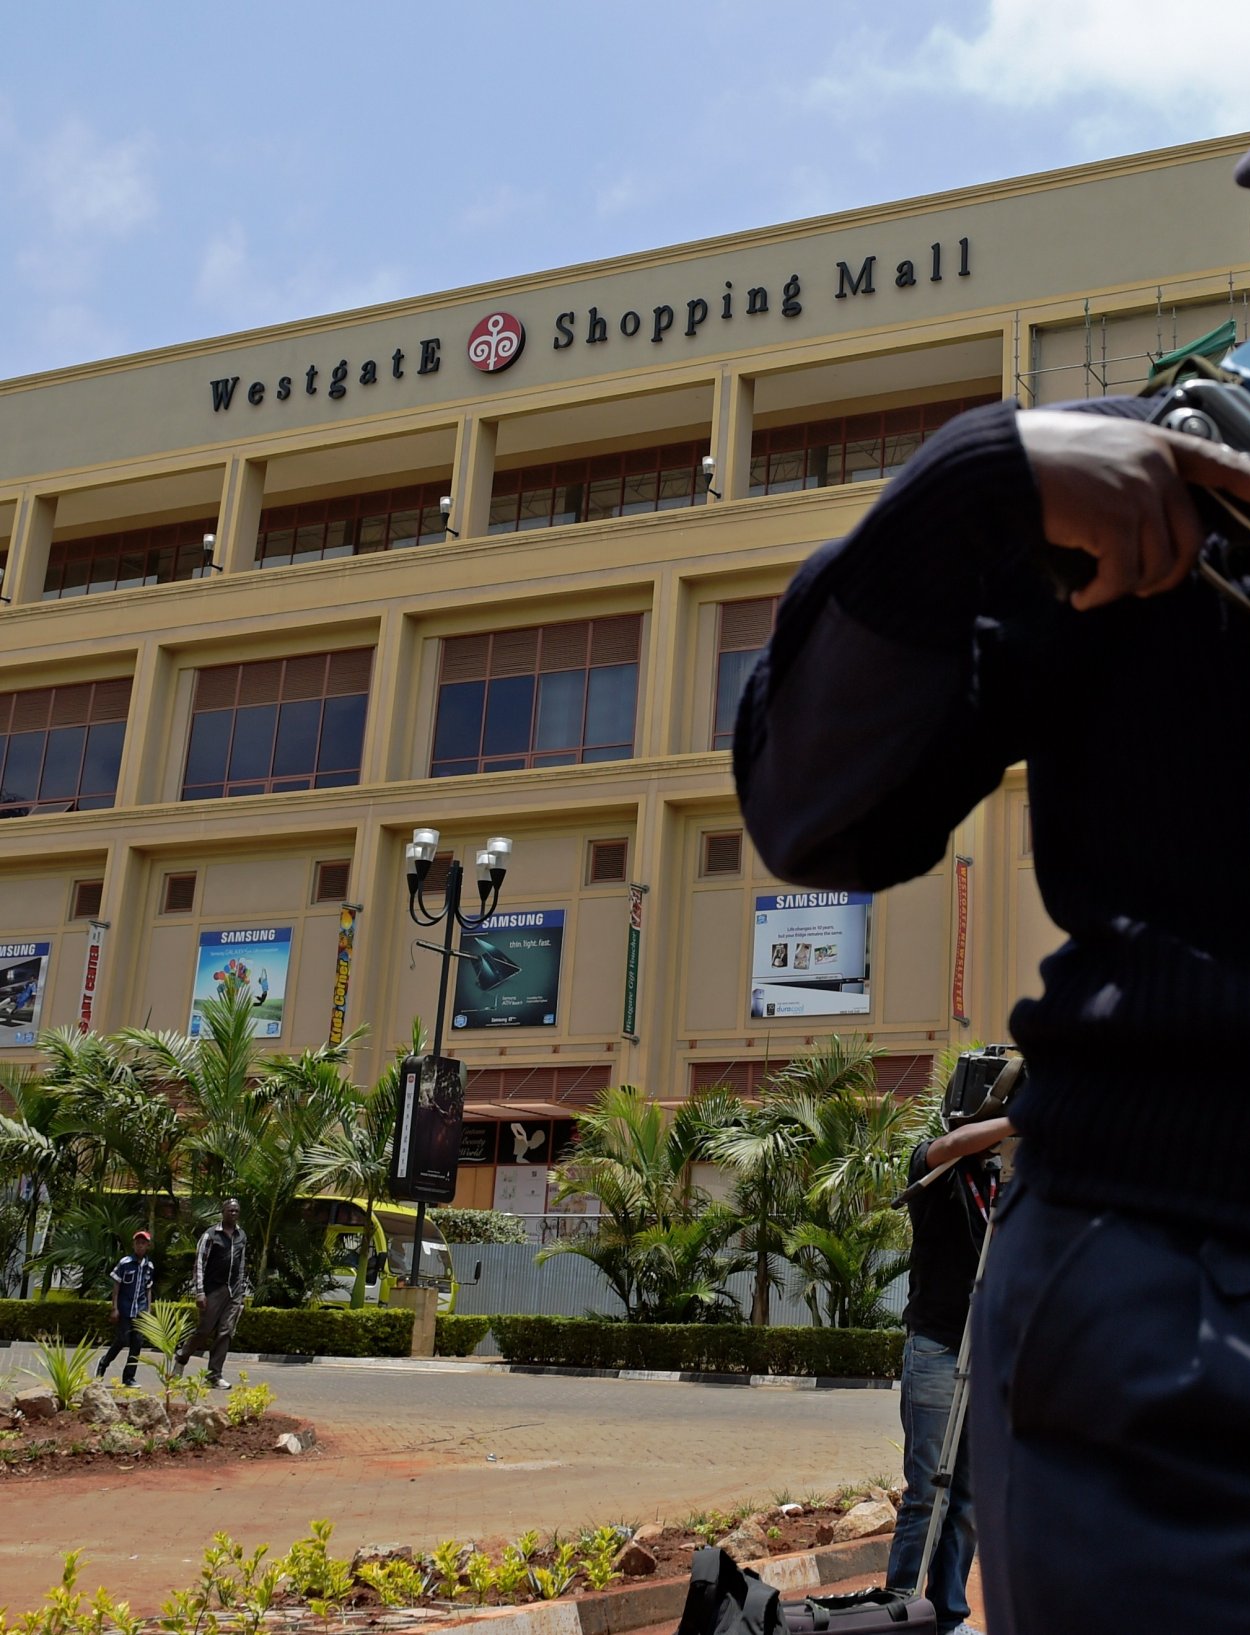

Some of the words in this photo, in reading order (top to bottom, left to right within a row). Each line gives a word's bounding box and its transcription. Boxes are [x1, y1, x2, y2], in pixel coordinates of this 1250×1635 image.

[210, 338, 441, 412] WestgatE
[553, 273, 802, 350] Shopping
[834, 236, 971, 299] Mall
[776, 891, 849, 909] SAMSUNG
[482, 913, 544, 929] SAMSUNG
[221, 929, 276, 943] SAMSUNG
[333, 959, 348, 1006] Corner
[331, 1010, 343, 1043] Kids
